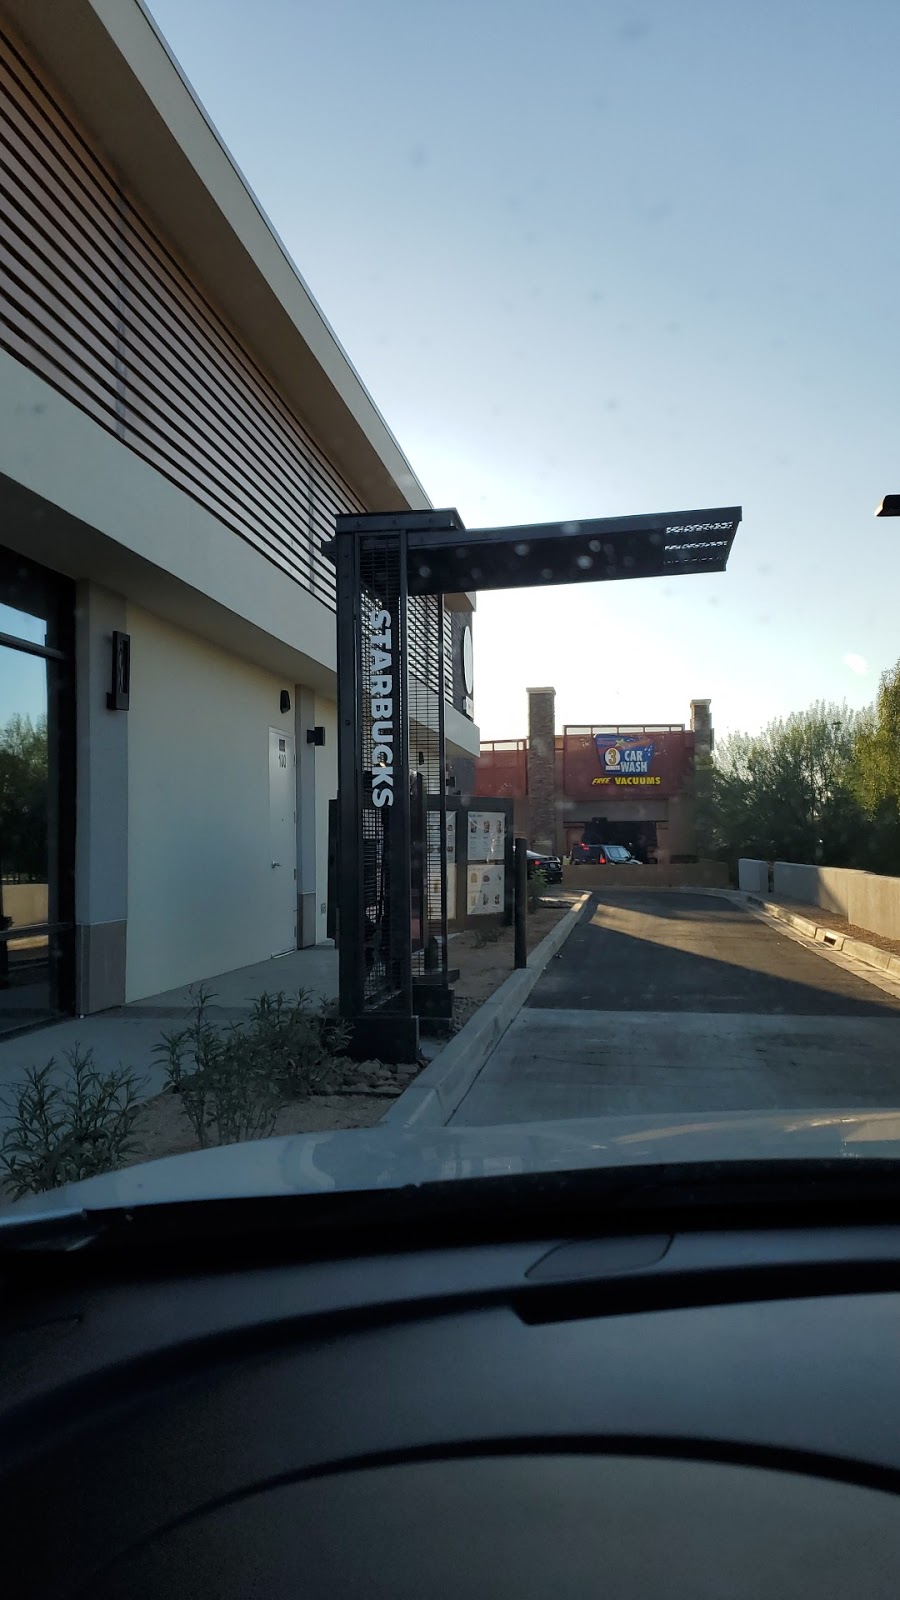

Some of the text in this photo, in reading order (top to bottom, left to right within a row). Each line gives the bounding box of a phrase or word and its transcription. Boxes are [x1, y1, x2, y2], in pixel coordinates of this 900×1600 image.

[370, 609, 394, 808] STARBUCKS
[608, 749, 617, 765] 3
[624, 750, 643, 762] CAR
[620, 761, 647, 773] WASH
[614, 776, 661, 785] VACUUMS
